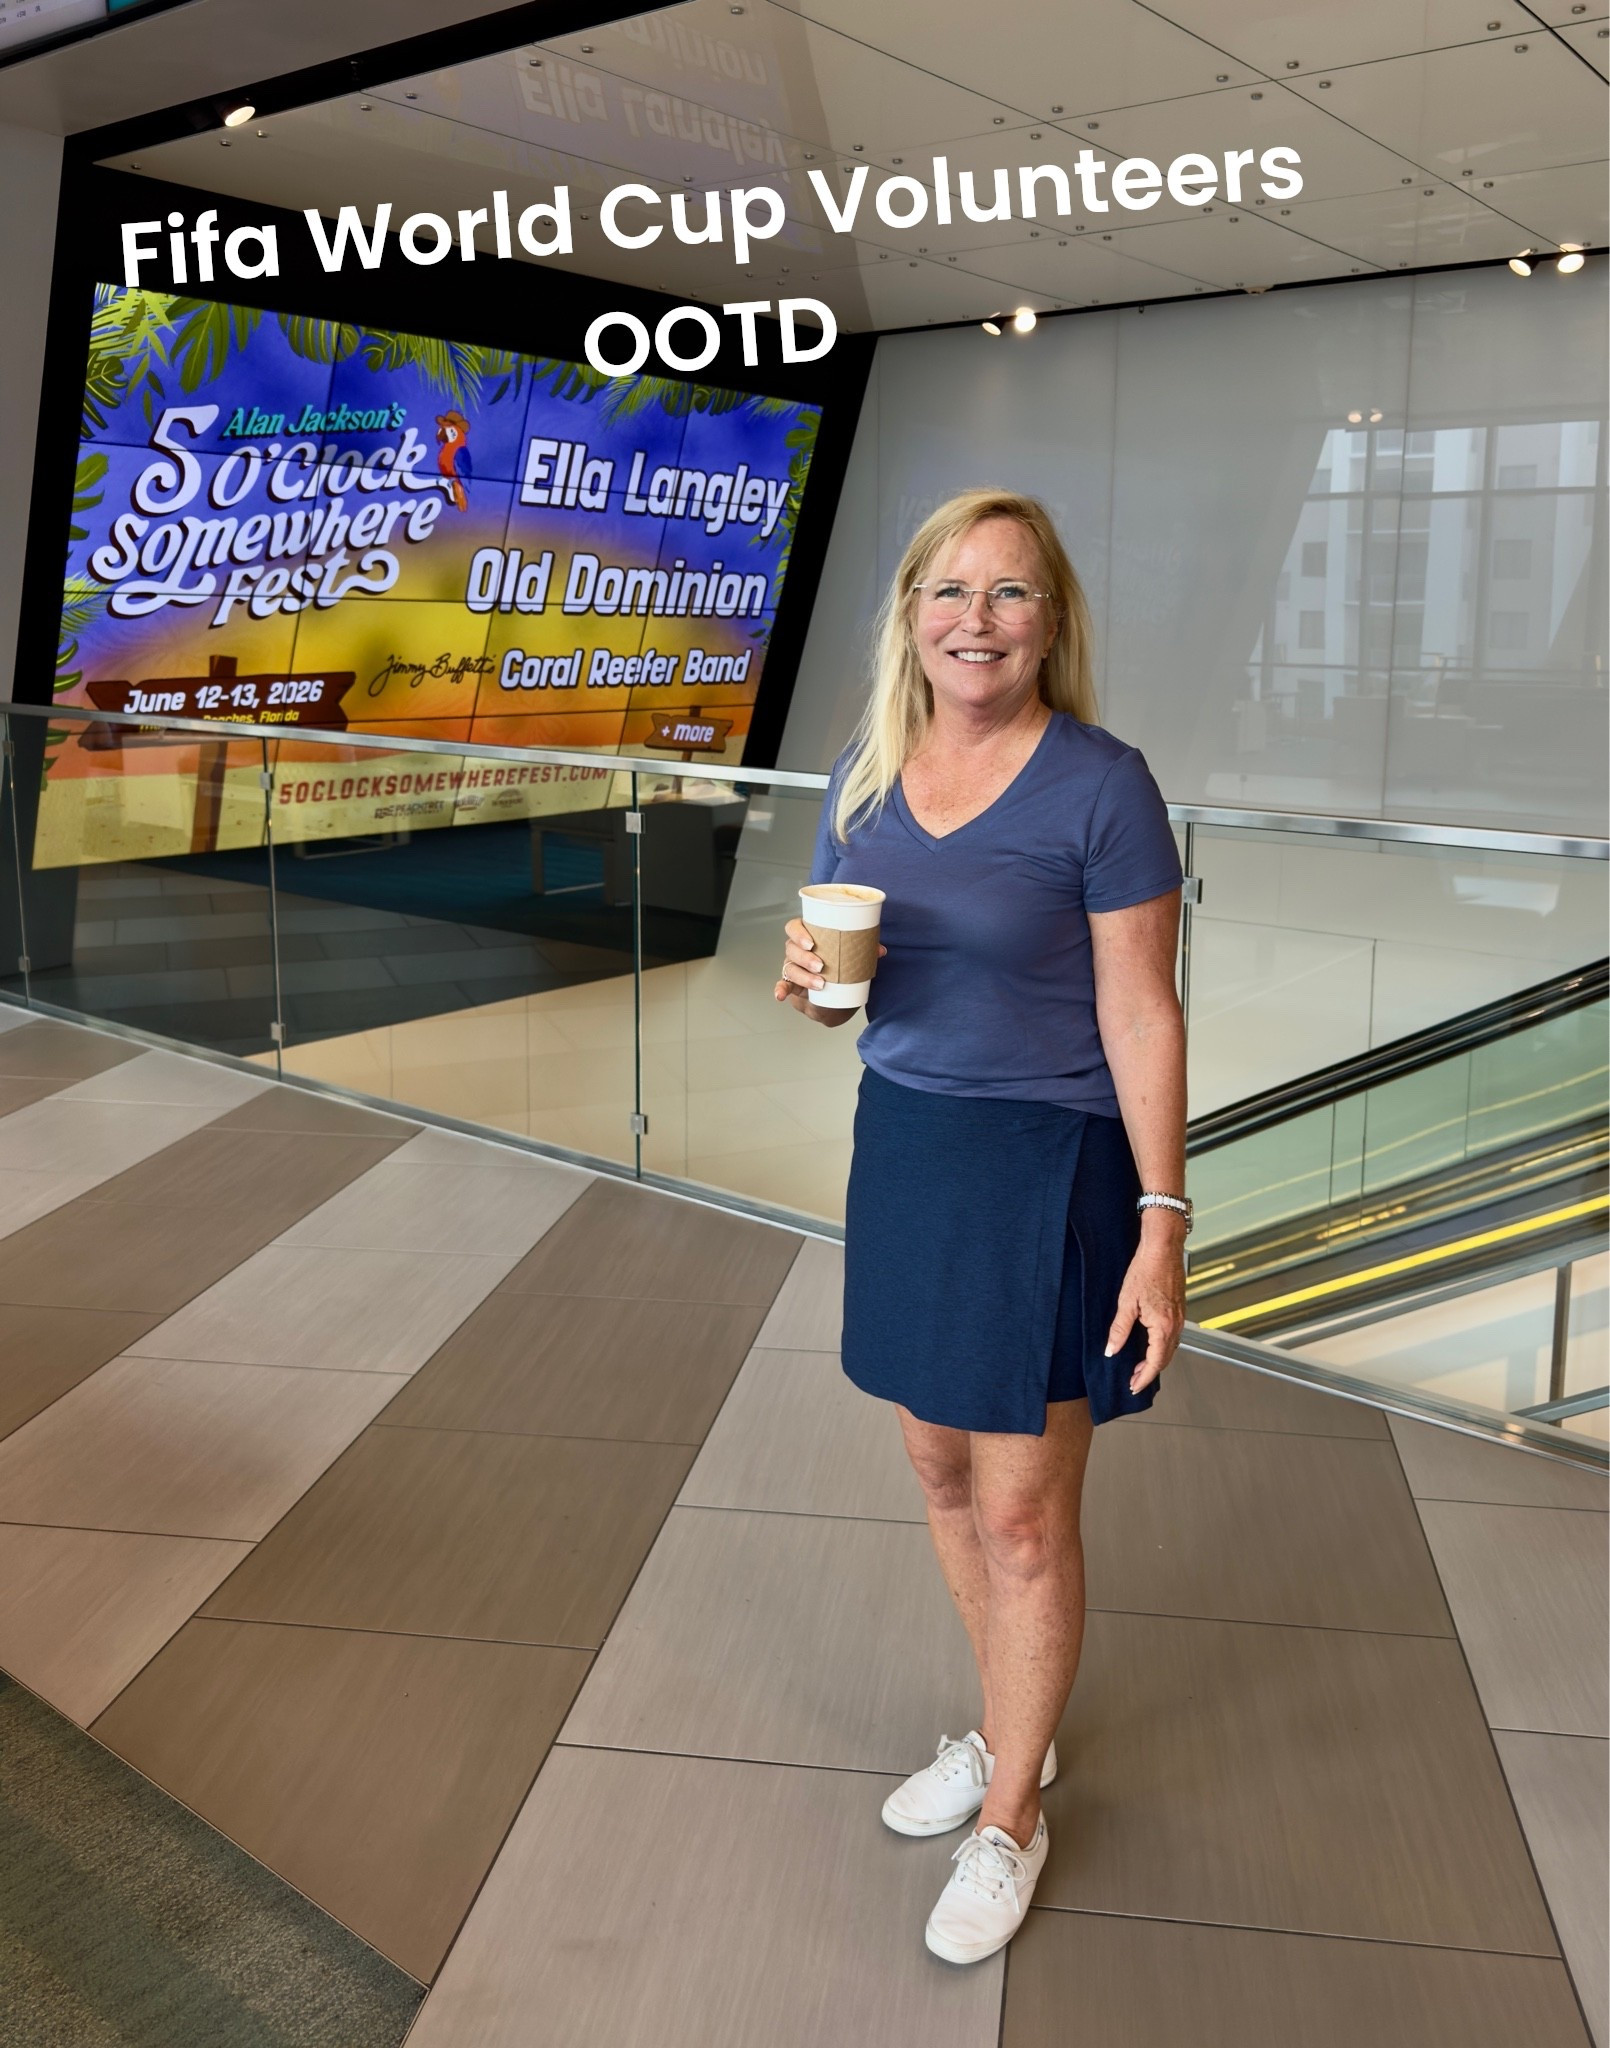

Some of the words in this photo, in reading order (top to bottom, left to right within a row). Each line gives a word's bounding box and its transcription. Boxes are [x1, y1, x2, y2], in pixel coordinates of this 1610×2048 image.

[222, 407, 286, 437] Alan
[289, 402, 407, 433] Jackson's
[135, 404, 220, 514] 5
[211, 427, 456, 504] O'Clock
[520, 437, 614, 510] Ella
[623, 450, 790, 537] Langley
[465, 547, 554, 614] Old
[563, 553, 767, 617] Dominion
[368, 653, 426, 697] Jimmy
[499, 649, 584, 689] Coral
[588, 648, 678, 687] Reefer
[683, 649, 752, 684] Band
[123, 689, 187, 714] June
[195, 683, 260, 709] 12-13,
[266, 679, 325, 705] 2026
[260, 709, 300, 724] Florida
[661, 725, 670, 737] +
[673, 723, 715, 743] more
